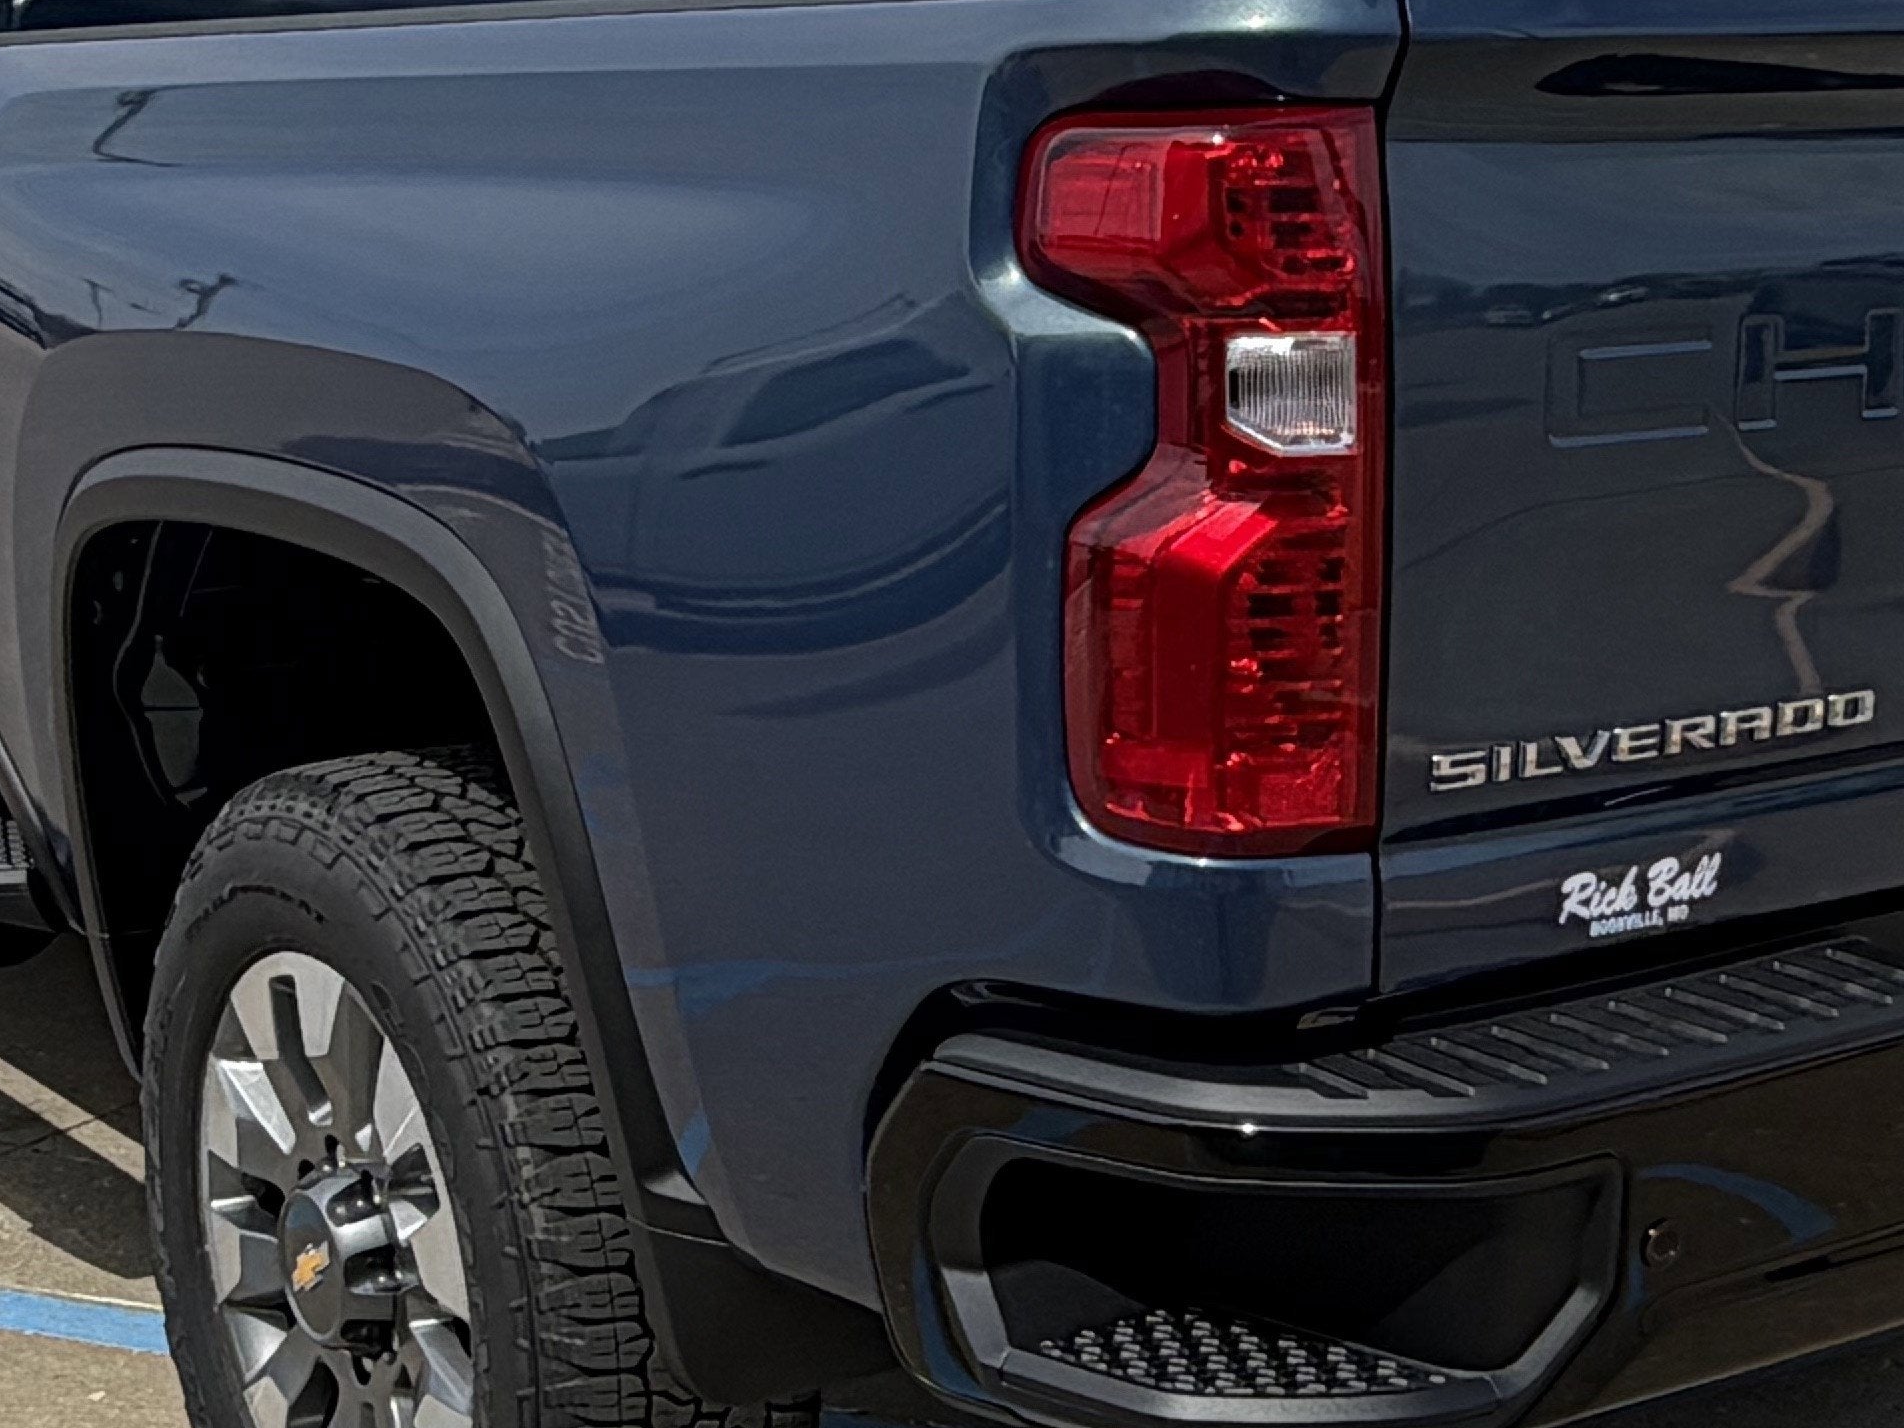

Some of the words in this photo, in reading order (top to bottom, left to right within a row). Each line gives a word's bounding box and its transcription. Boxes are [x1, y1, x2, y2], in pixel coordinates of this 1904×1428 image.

[1429, 688, 1876, 792] SILVERADO
[1558, 865, 1639, 925] Rick
[1647, 851, 1722, 908] Ball
